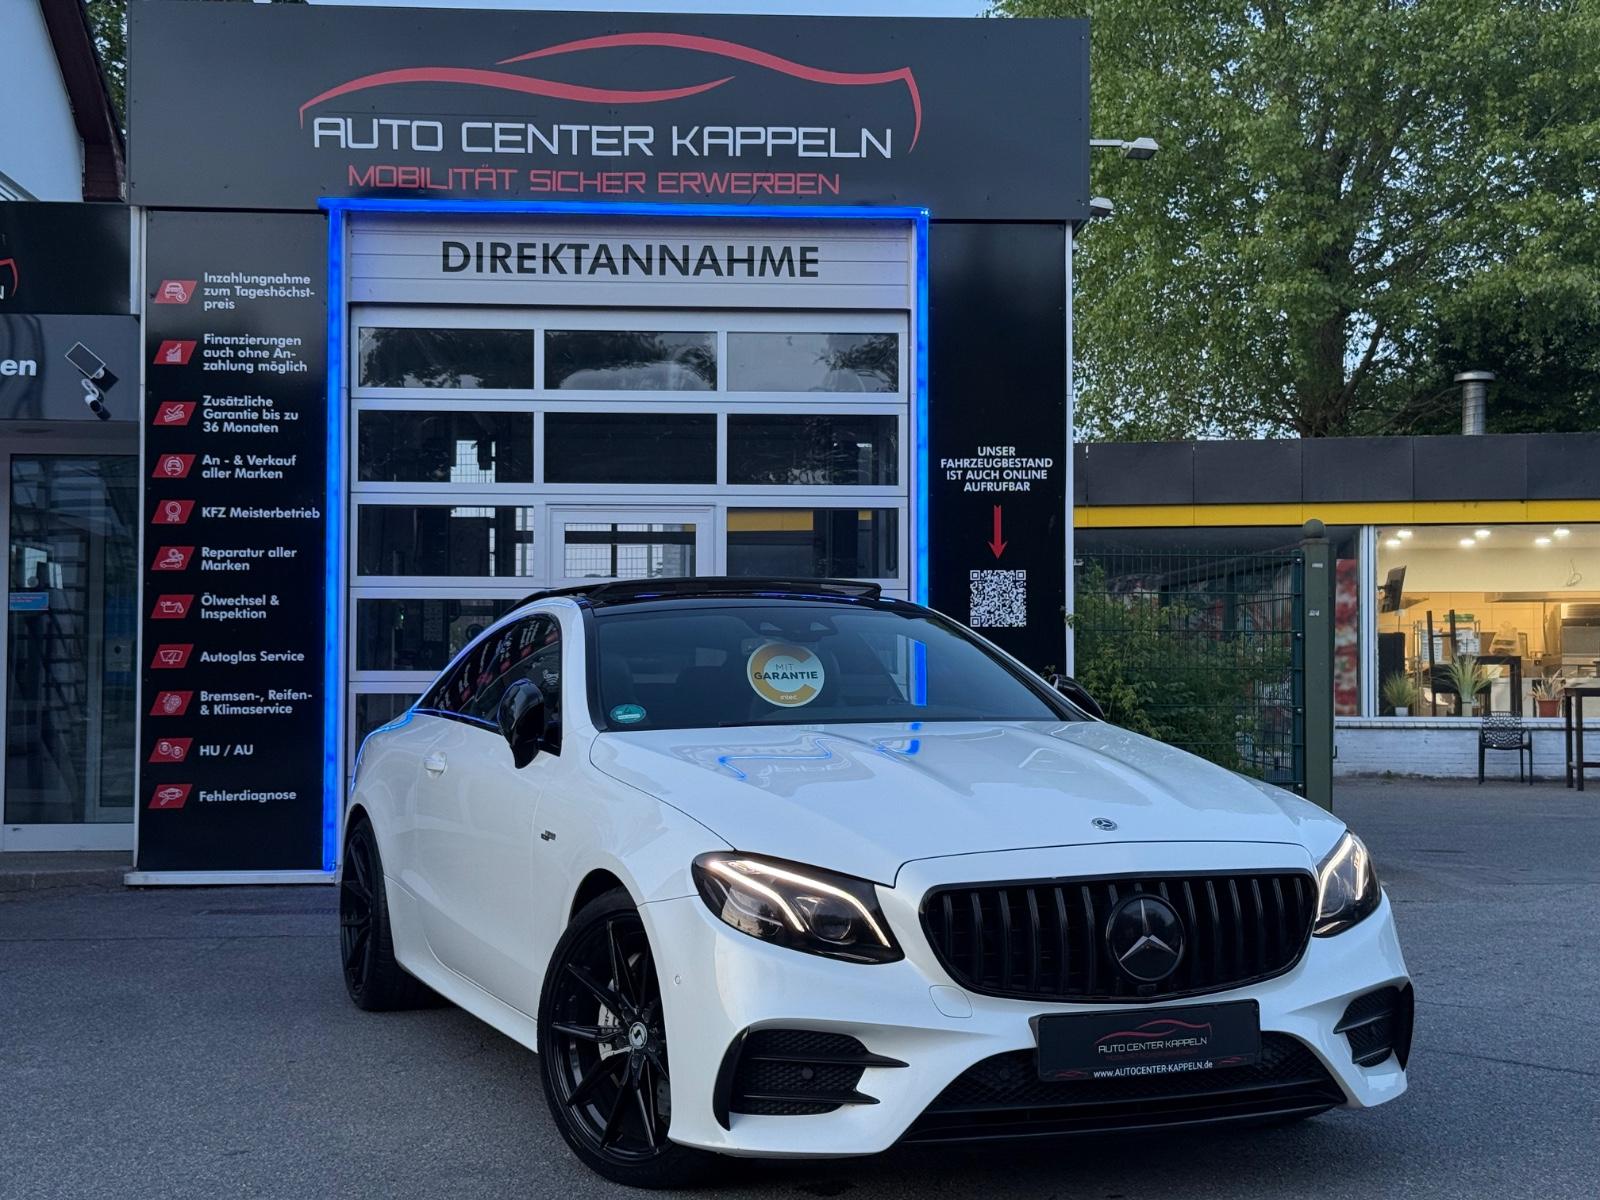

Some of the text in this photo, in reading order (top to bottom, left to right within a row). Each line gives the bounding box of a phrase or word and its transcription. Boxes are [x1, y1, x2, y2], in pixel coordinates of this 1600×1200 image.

[314, 118, 891, 158] AUTO CENTER KAPPELN
[348, 163, 840, 194] MOBILITÄT SICHER ERWERBEN
[442, 241, 820, 277] DIREKTANNAHME
[204, 272, 310, 286] Inzahlungnahme
[204, 285, 315, 298] zum Tageshöchst-
[204, 299, 235, 311] preis
[203, 333, 302, 347] Finanzierungen
[204, 346, 296, 358] auch ohne An-
[204, 360, 307, 374] zahlung möglich
[203, 395, 273, 406] Zusätzliche
[203, 409, 258, 419] Garantie
[263, 409, 280, 420] bis
[203, 422, 278, 432] 36 Monaten
[978, 447, 1015, 456] UNSER
[234, 455, 242, 465] &
[247, 455, 296, 465] Verkauf
[941, 458, 1052, 468] FAHRZEUGBESTAND
[202, 467, 282, 478] aller Marken
[947, 470, 1047, 480] IST AUCH ONLINE
[964, 482, 1030, 491] AUFRUFBAR
[202, 507, 320, 518] KFZ Meisterbetrieb
[201, 547, 297, 559] Reparatur aller
[201, 560, 249, 570] Marken
[201, 592, 279, 605] Ölwechsel &
[201, 608, 266, 620] Inspektion
[200, 651, 304, 663] Autoglas Service
[775, 663, 794, 671] MIT
[753, 671, 818, 680] GARANTIE
[201, 689, 312, 702] Bremsen-, Reifen-
[200, 703, 292, 715] & Klimaservice
[200, 745, 253, 756] HU / AU
[200, 790, 296, 802] Fehlerdiagnose
[1098, 1036, 1207, 1054] AUTO CENTER KAPPELN
[1093, 1060, 1213, 1078] www.AUTOCENTER-KAPPELN.de
